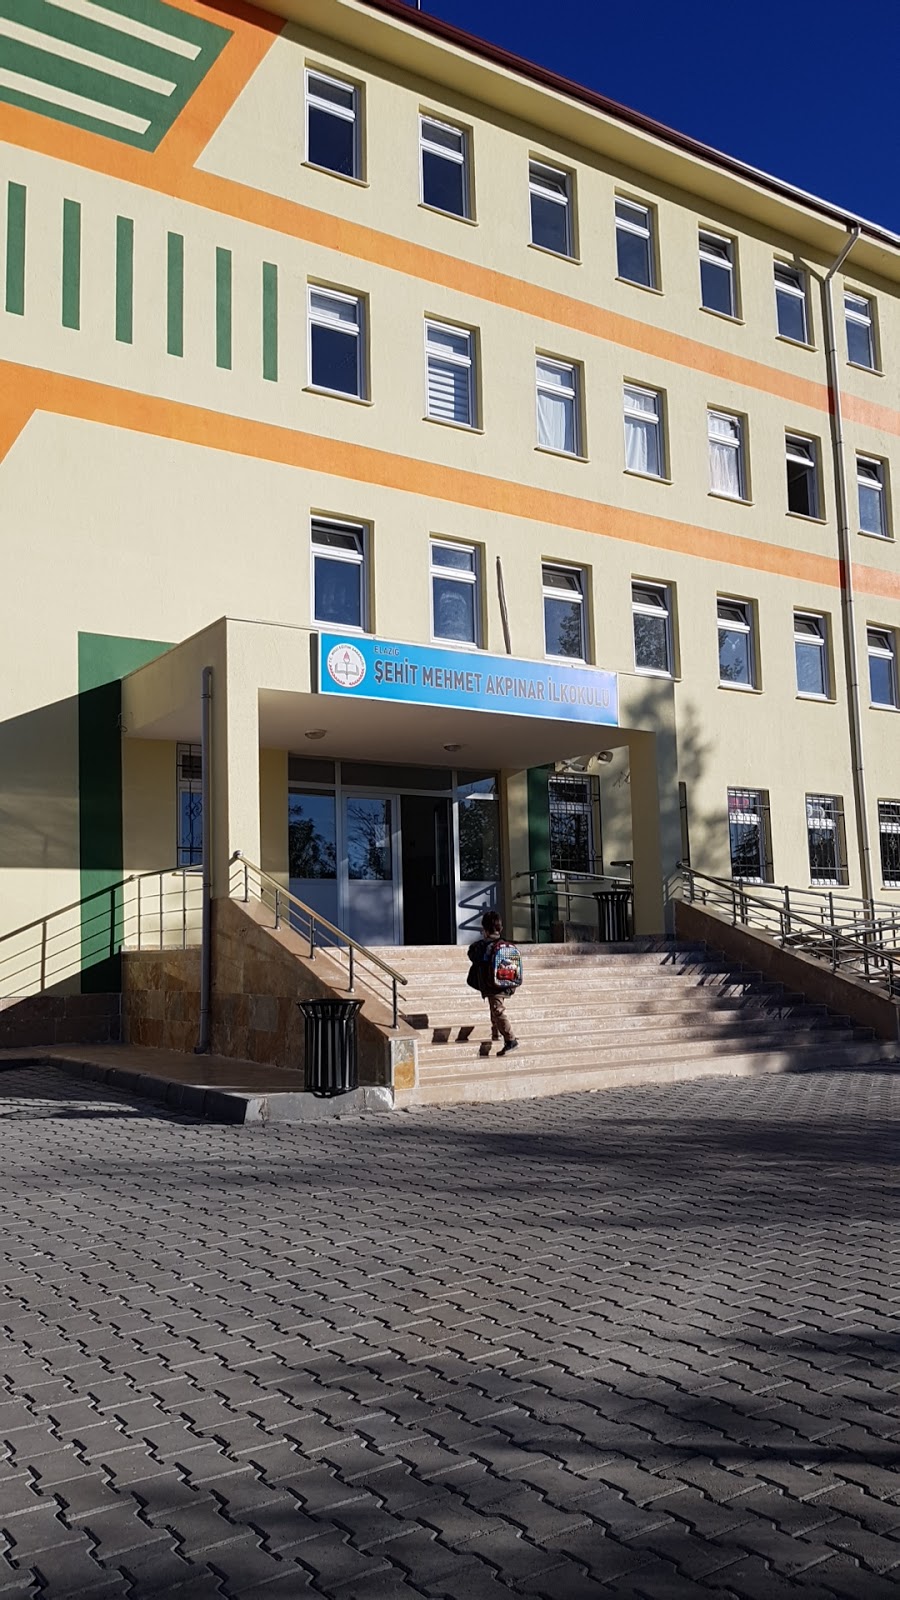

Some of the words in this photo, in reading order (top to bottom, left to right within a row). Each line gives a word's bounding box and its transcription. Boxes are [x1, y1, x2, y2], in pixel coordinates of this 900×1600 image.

[374, 658, 419, 685] ŞEHİT
[422, 666, 482, 693] MEHMET
[486, 674, 546, 700] AKPINAR
[548, 677, 610, 707] İLKOKULU
